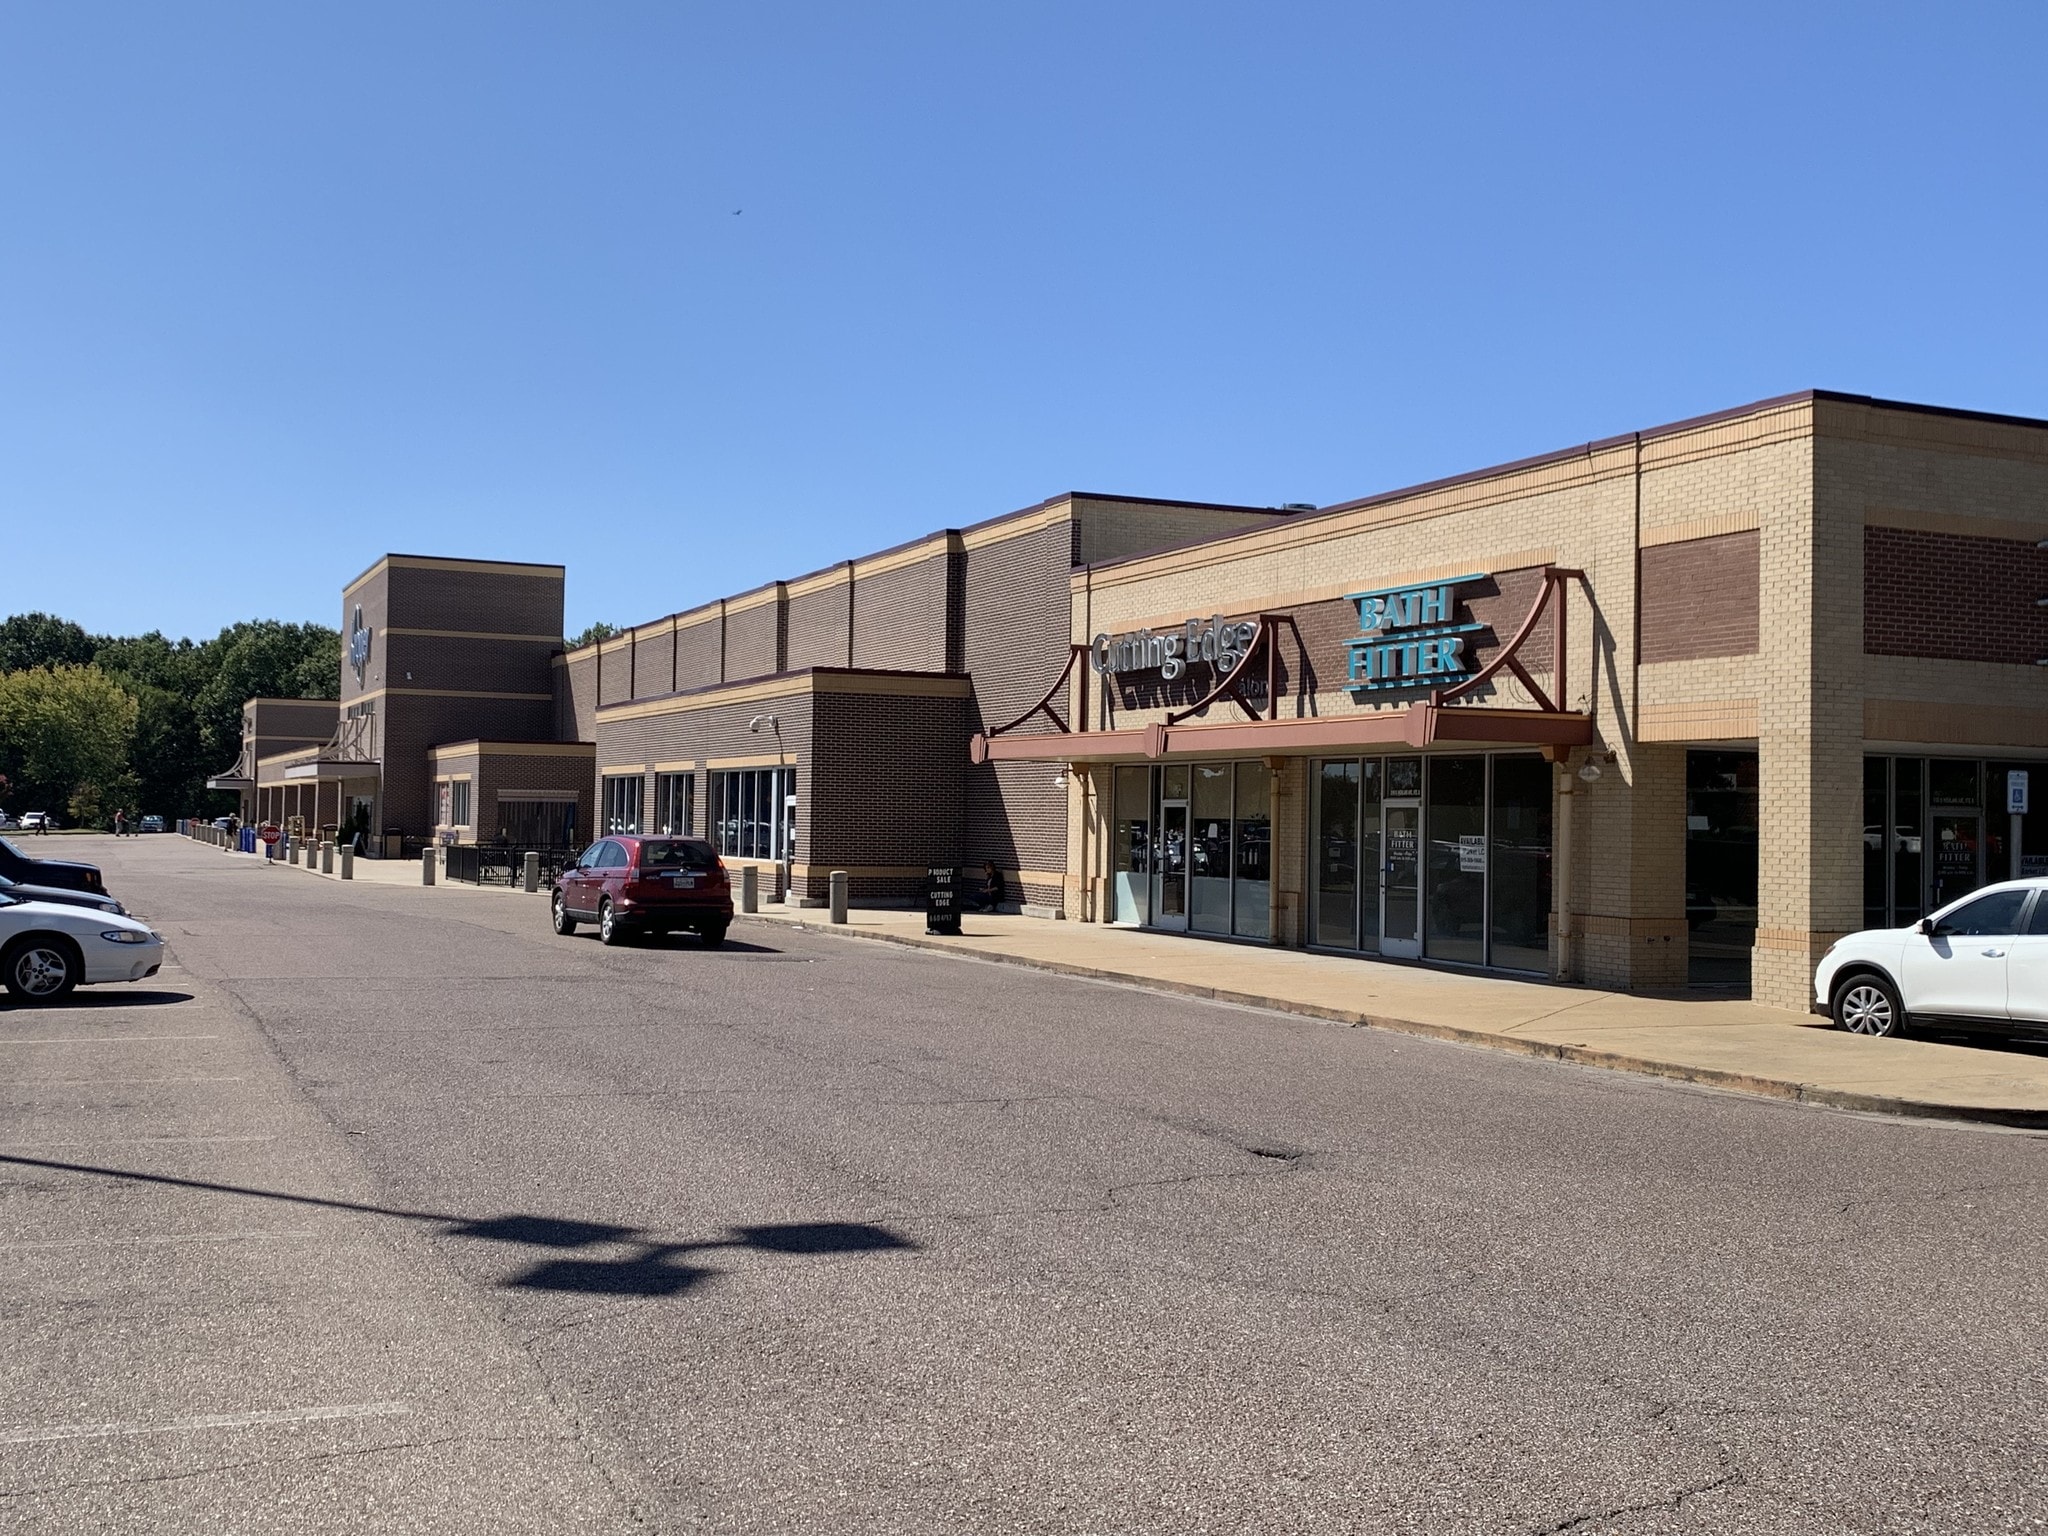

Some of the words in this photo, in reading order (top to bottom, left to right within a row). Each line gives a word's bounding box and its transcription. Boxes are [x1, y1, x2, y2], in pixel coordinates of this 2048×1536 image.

[1360, 586, 1454, 631] BATH
[1091, 627, 1186, 680] Cutting
[1185, 614, 1257, 673] Edge
[1348, 637, 1465, 681] FITTER
[263, 831, 280, 840] STOP
[1391, 840, 1414, 848] FITTER
[1939, 852, 1970, 861] FITTER
[936, 876, 951, 884] SALE
[930, 891, 953, 899] CUTTING
[935, 899, 950, 907] EDGE
